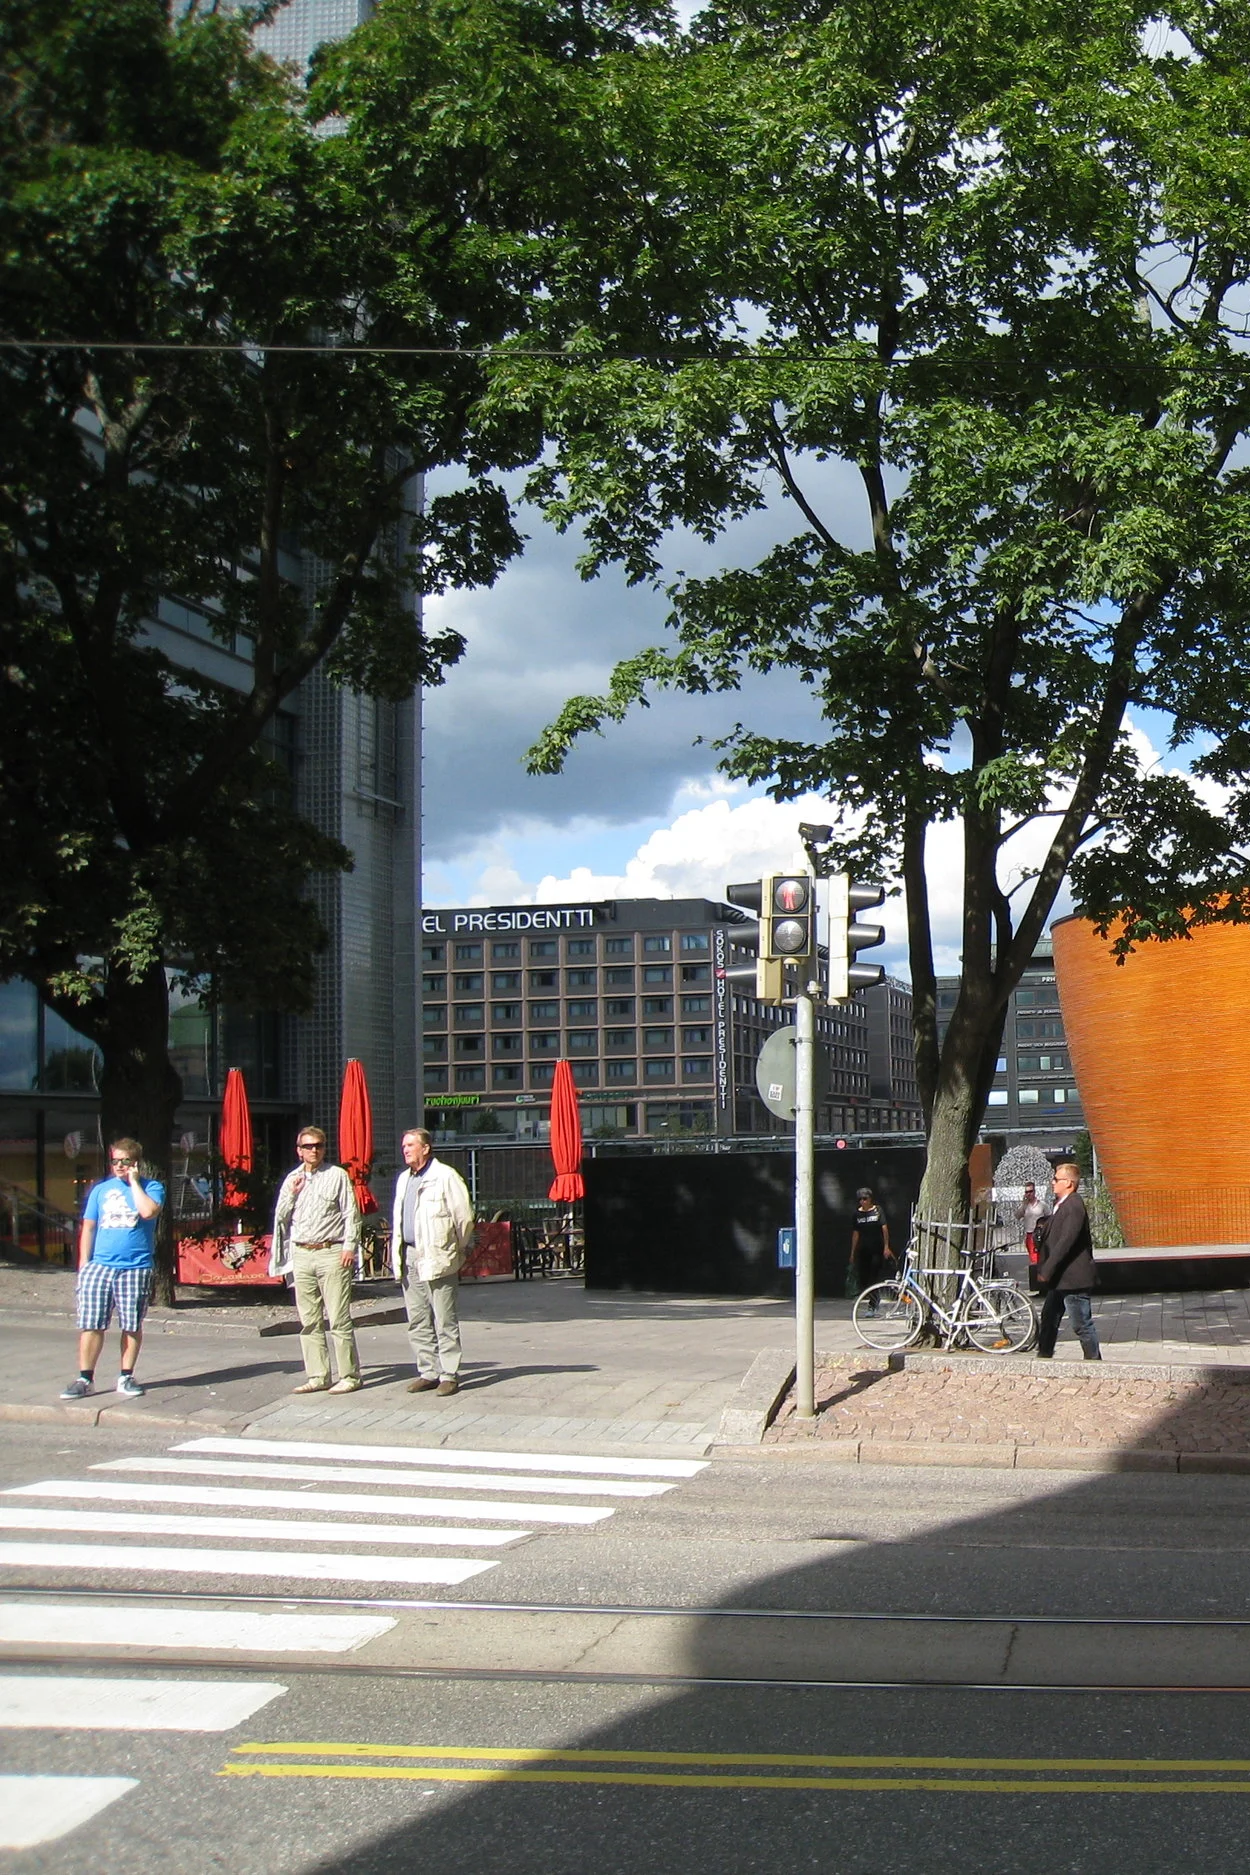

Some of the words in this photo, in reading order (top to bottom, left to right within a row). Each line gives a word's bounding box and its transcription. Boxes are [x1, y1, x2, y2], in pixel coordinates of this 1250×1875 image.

[422, 915, 447, 933] EL
[454, 908, 594, 932] PRESIDENTTI
[715, 929, 725, 969] SOKOS
[716, 979, 726, 1018] HOTEL
[717, 1021, 728, 1109] PRESIDENTTI
